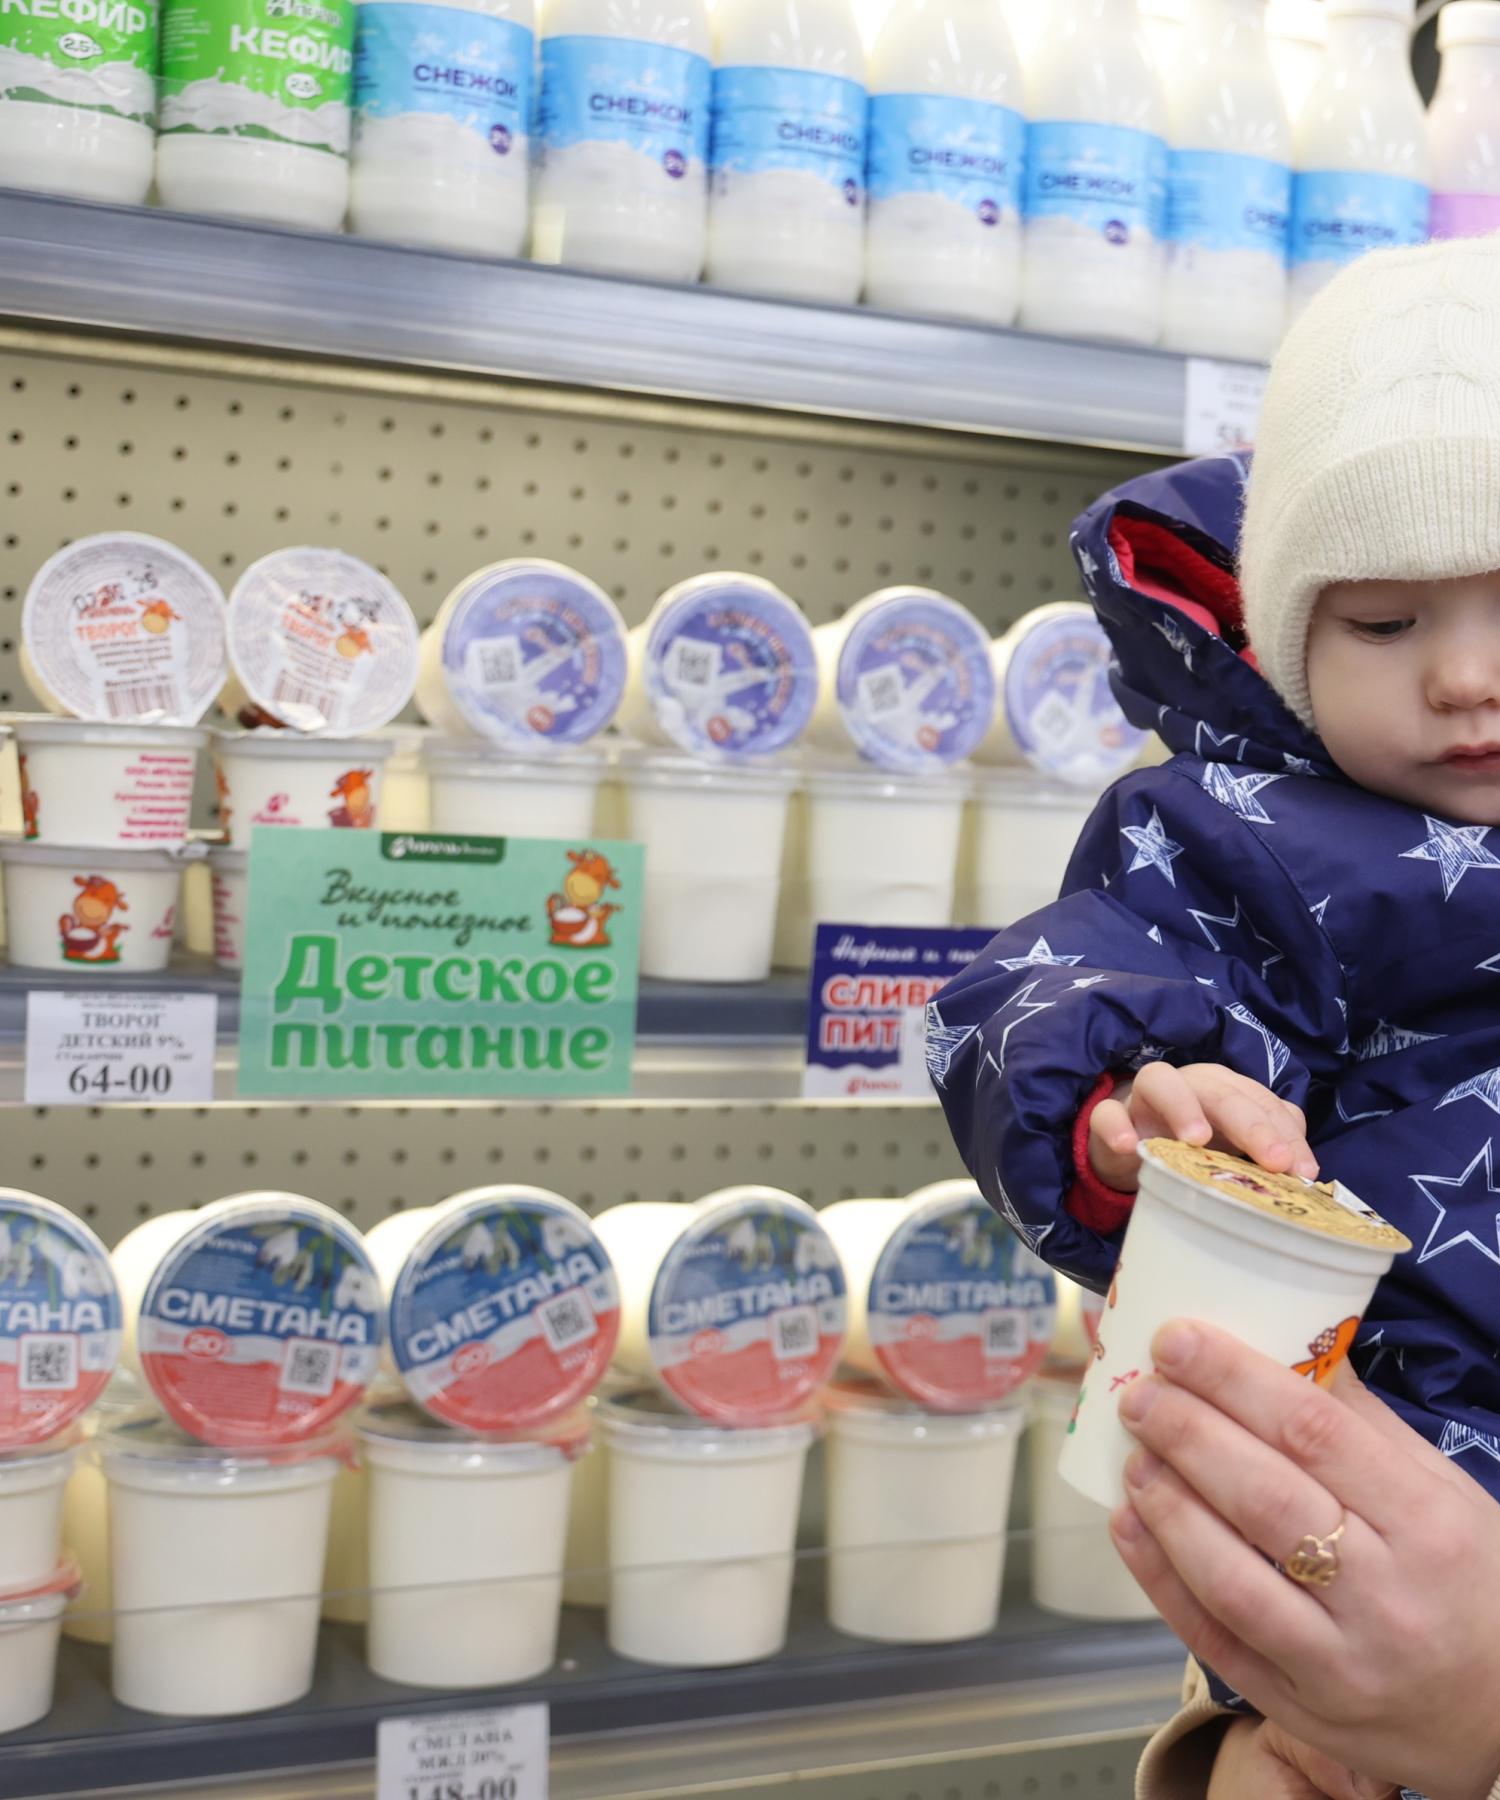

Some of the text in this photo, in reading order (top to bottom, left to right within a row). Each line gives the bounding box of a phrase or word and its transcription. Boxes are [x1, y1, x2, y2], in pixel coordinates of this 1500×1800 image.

[413, 64, 518, 98] СНЕЖОК
[589, 94, 693, 123] СНЕЖОК
[908, 147, 1006, 174] СНЕЖОК
[320, 868, 460, 917] Вкусное
[337, 912, 535, 947] и полезное
[274, 935, 614, 1014] Детское
[829, 978, 942, 1008] СЛИВ
[81, 1012, 166, 1029] ТВОРОГ
[59, 1032, 184, 1049] ДЕТСКИЙ 9%
[271, 1022, 610, 1071] питание
[69, 1063, 171, 1094] 64-00
[406, 1253, 598, 1362] СМЕТАНА
[662, 1273, 833, 1332] СМЕТАНА
[880, 1280, 1046, 1311] СМЕТАНА
[158, 1288, 367, 1343] СМЕТАНА
[409, 1729, 513, 1752] СМЕТАНА
